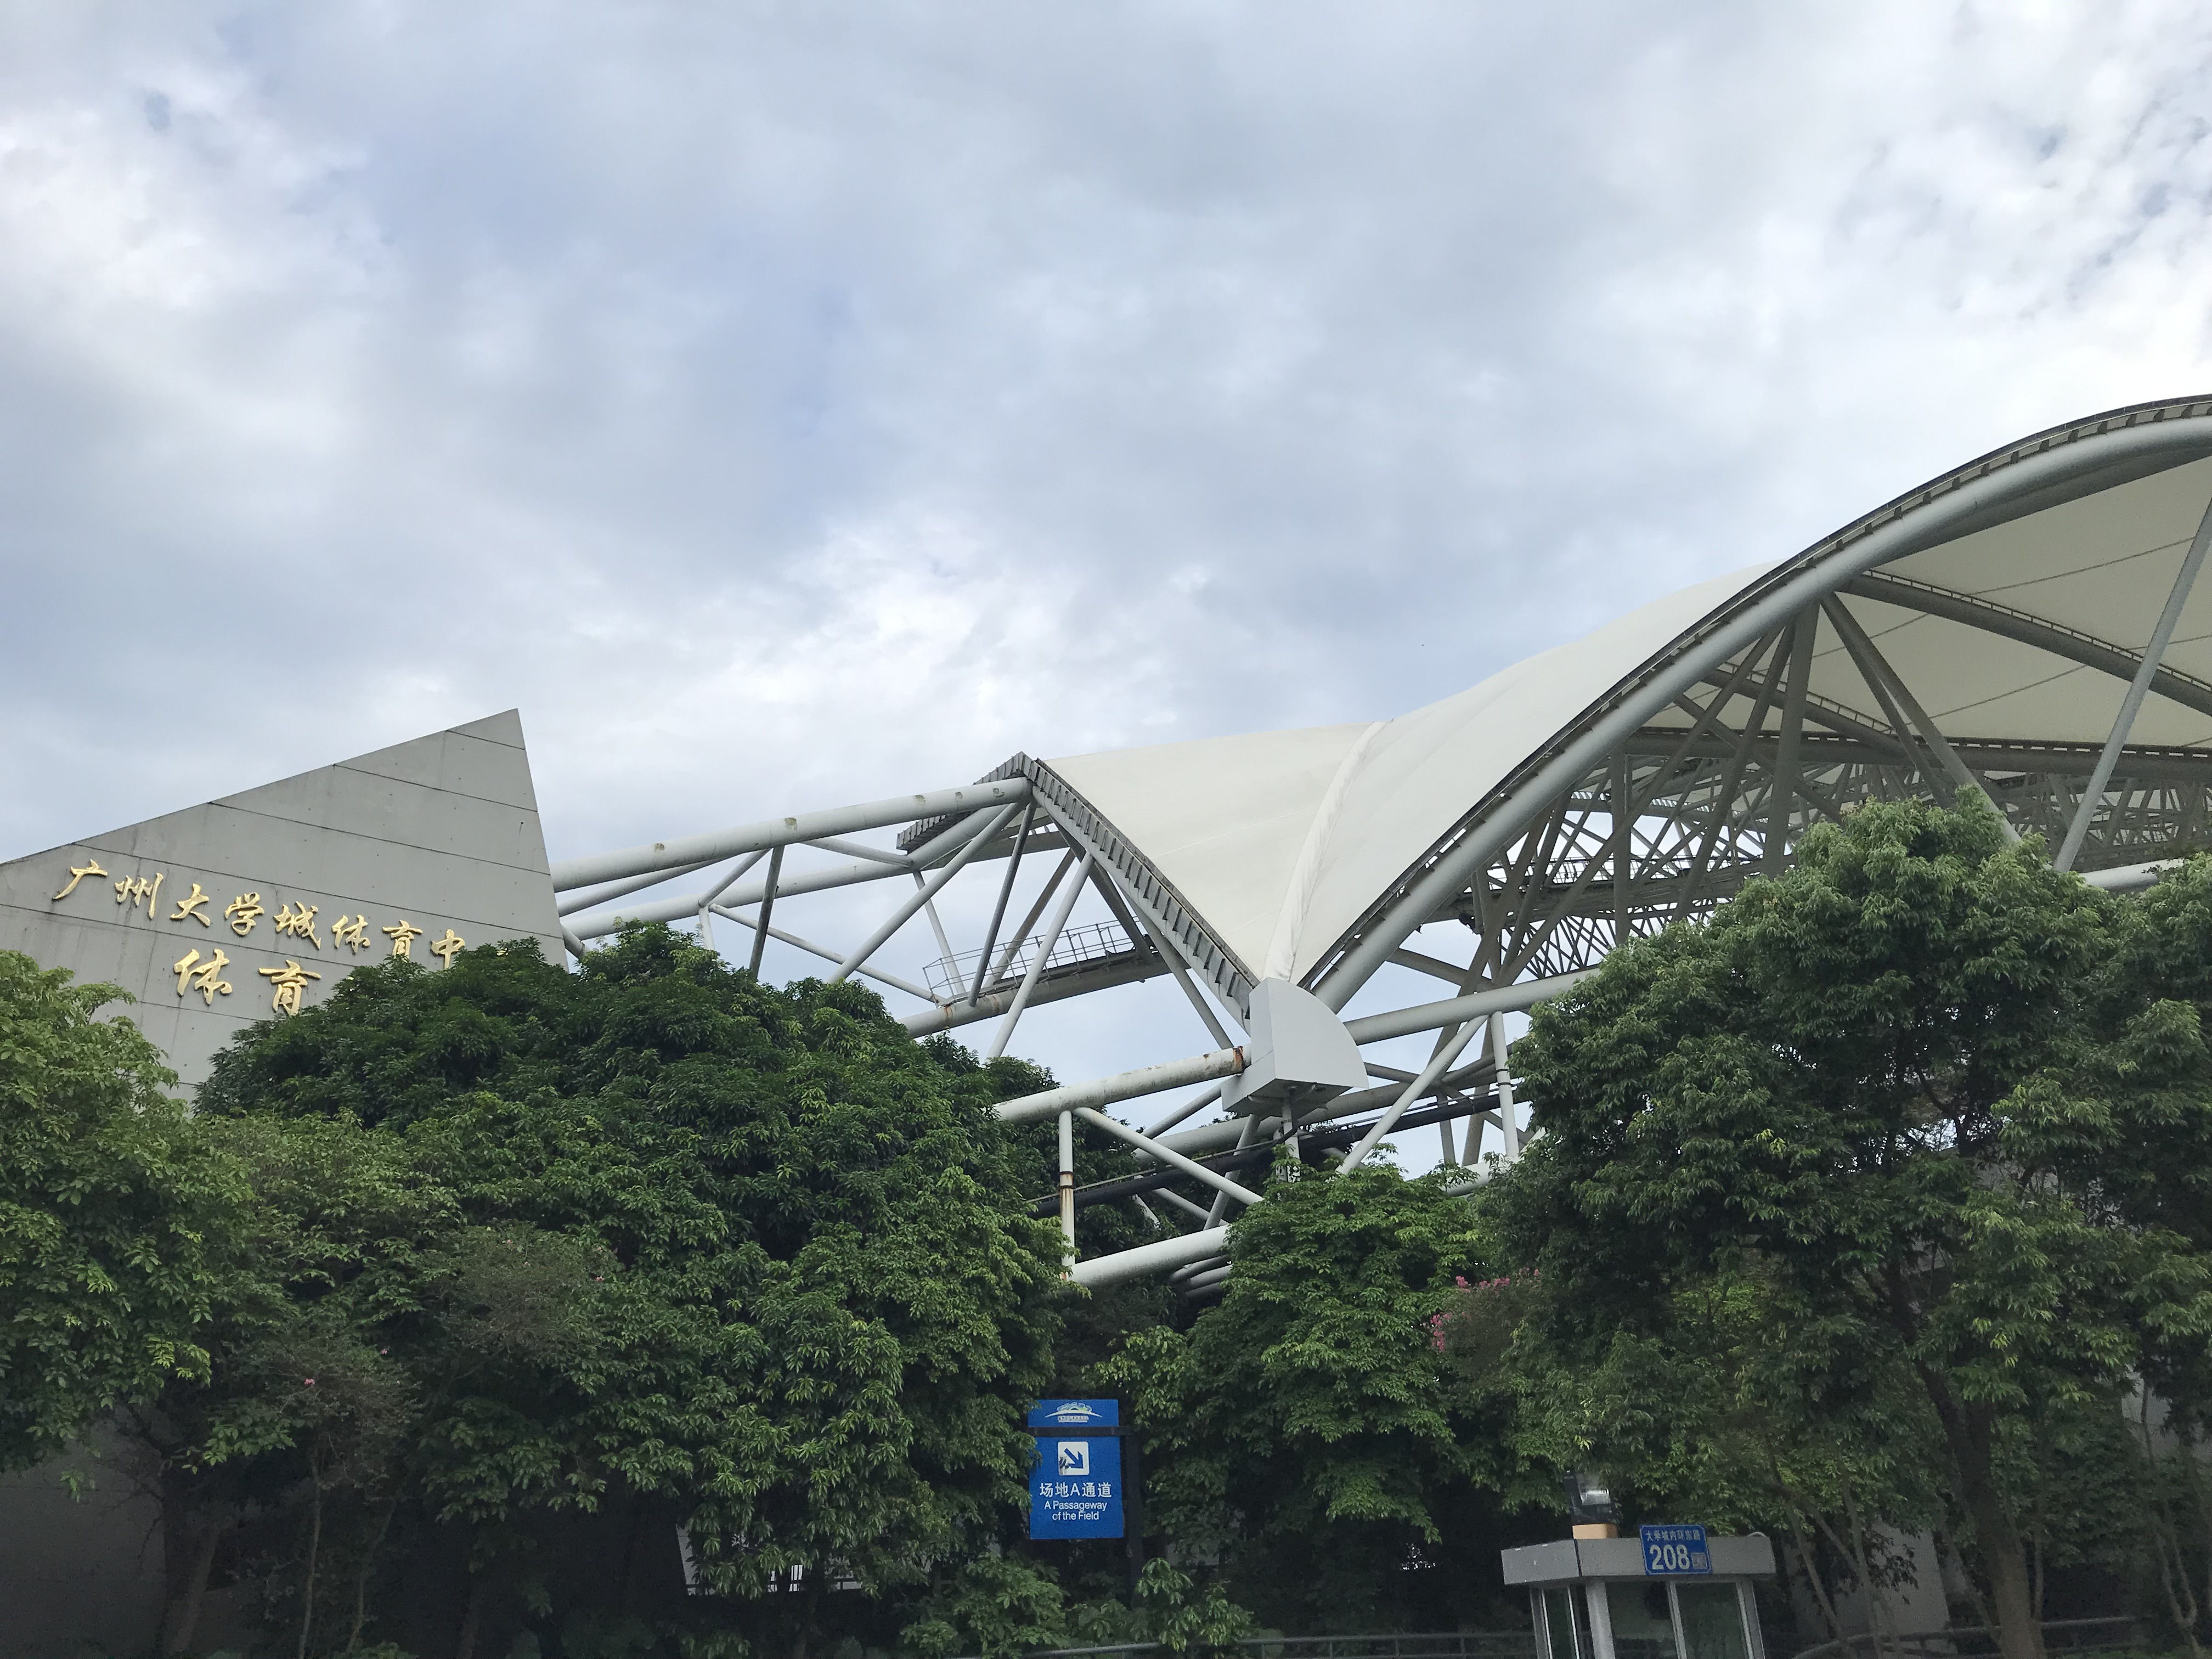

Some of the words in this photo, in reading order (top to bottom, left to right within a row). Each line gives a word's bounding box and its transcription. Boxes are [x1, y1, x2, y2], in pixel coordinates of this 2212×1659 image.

[53, 859, 509, 969] 广州大学城体育中
[1040, 1482, 1111, 1498] 场地A通道
[1044, 1500, 1051, 1510] A
[1053, 1500, 1107, 1511] Passageway
[1052, 1512, 1062, 1520] of
[1063, 1511, 1076, 1520] the
[1079, 1511, 1099, 1520] Field
[1650, 1544, 1690, 1570] 208
